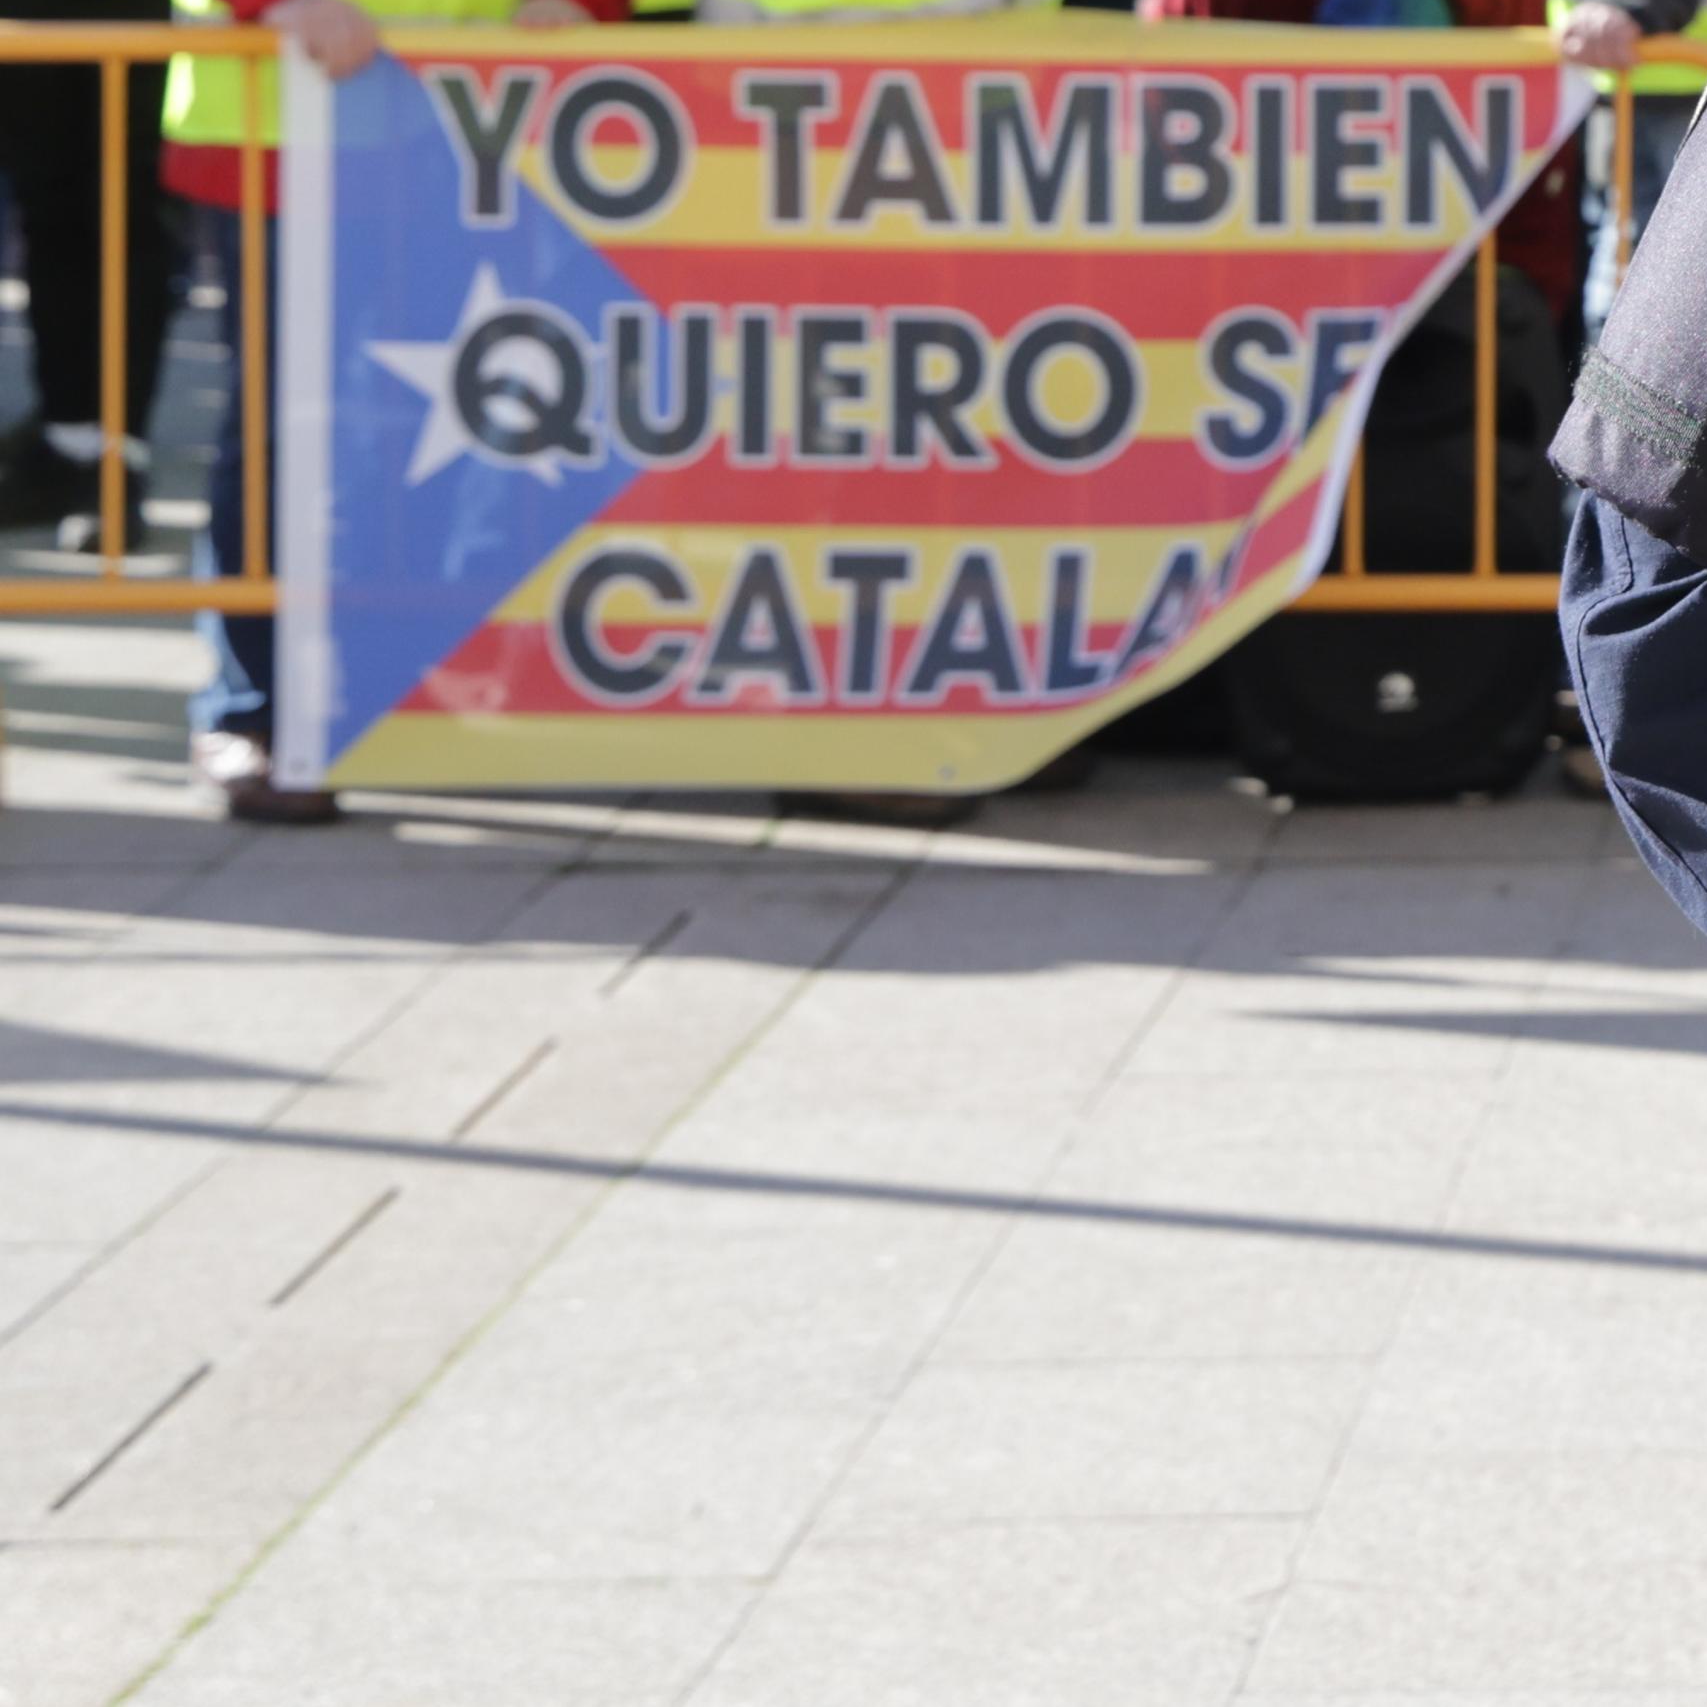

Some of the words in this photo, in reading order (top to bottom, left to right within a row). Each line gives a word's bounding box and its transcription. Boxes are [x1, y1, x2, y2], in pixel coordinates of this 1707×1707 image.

[432, 68, 690, 226] YO
[736, 74, 1522, 230] TAMBIEN
[450, 302, 1141, 472] QUIERO
[553, 534, 1246, 702] CATALA
